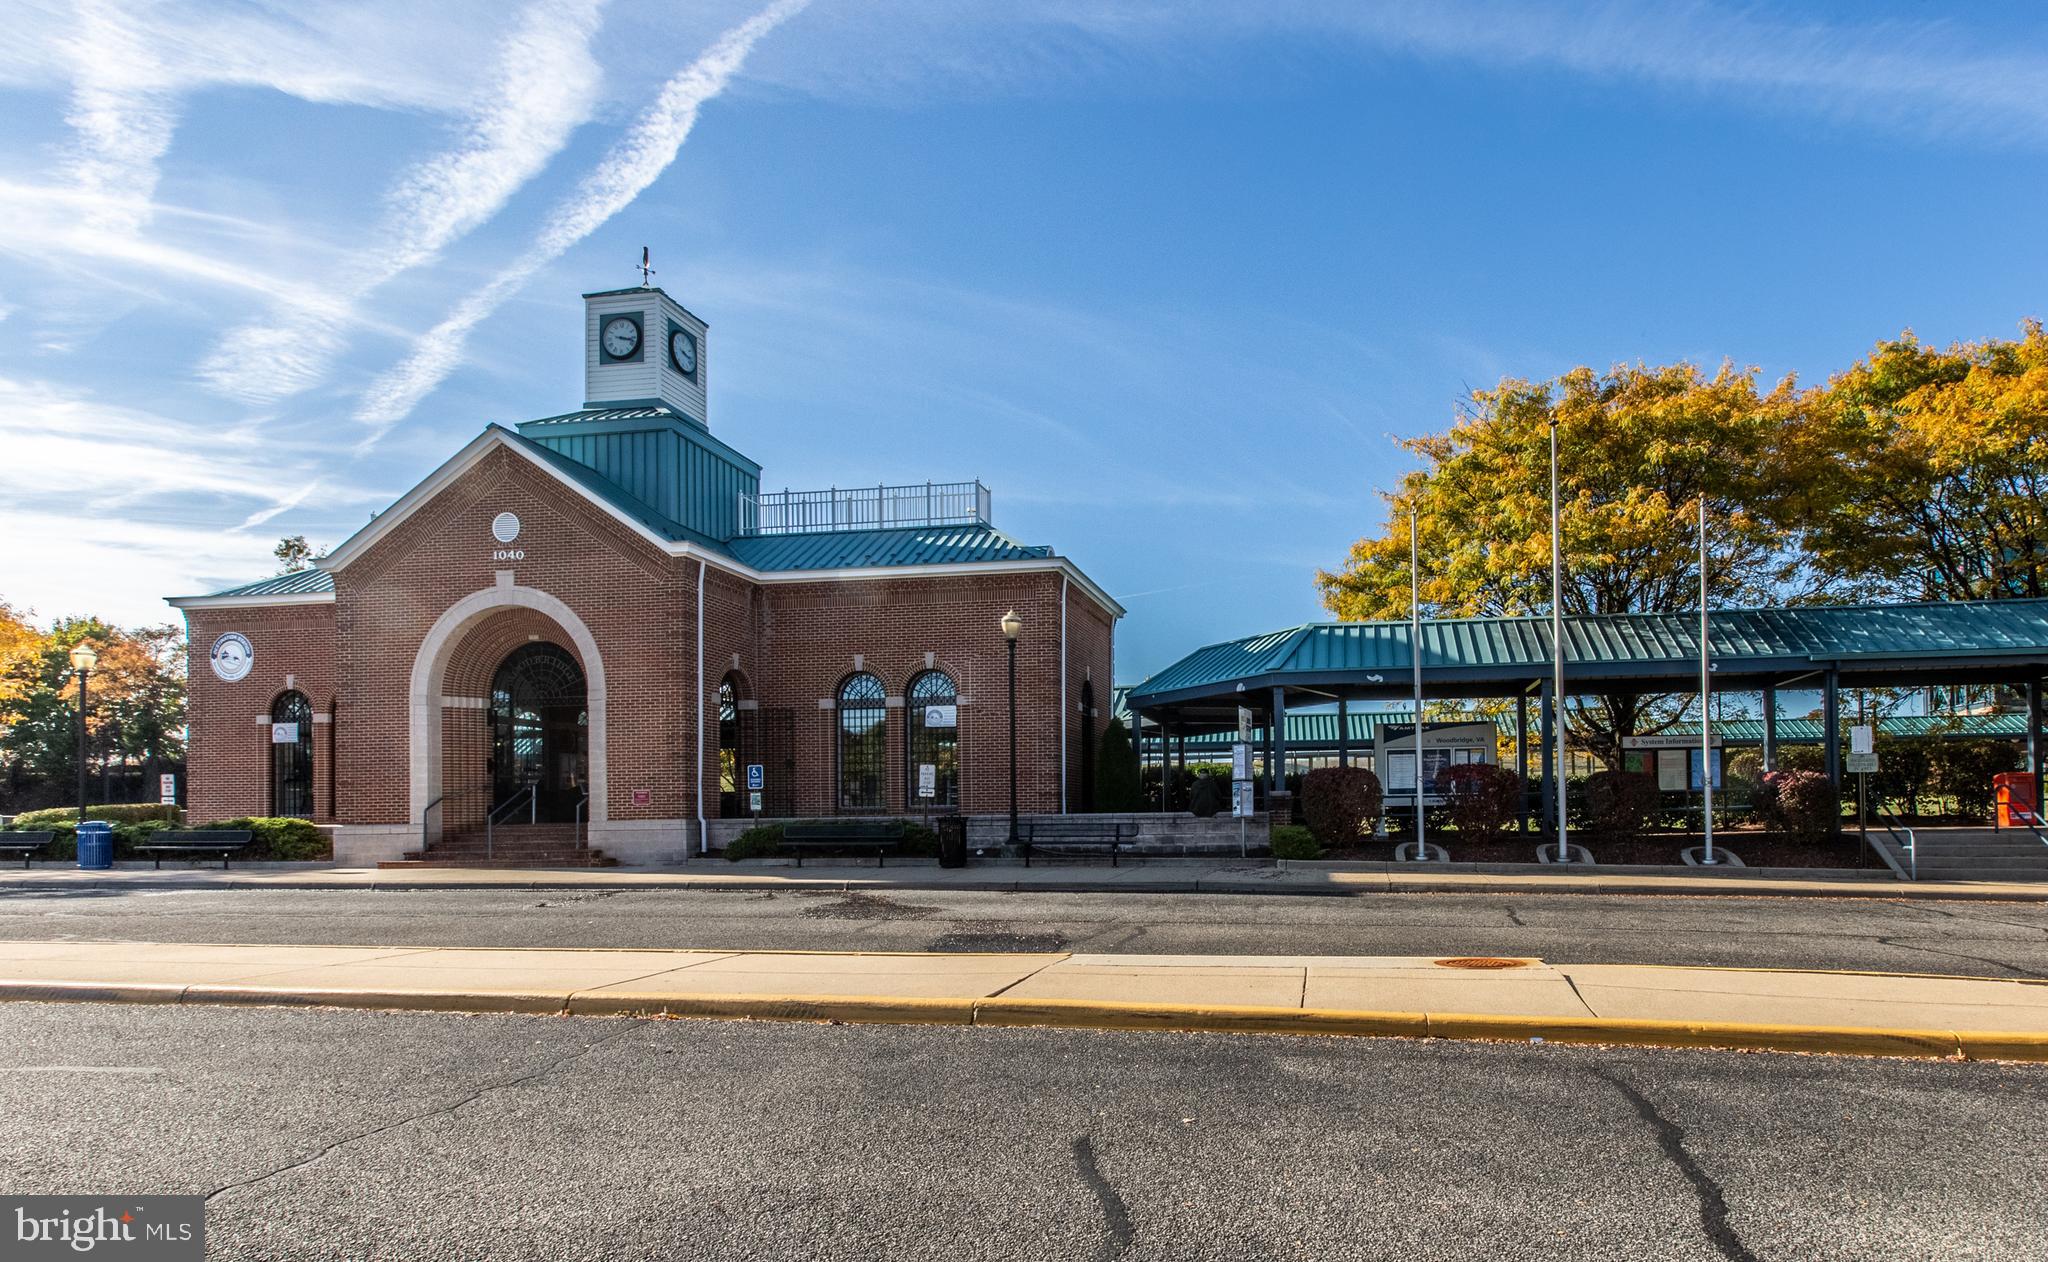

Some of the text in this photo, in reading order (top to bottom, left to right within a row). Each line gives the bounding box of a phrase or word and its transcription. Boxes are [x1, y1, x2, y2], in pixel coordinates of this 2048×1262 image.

[493, 550, 525, 560] 1040
[1435, 736, 1475, 744] Woodbridge,
[1640, 737, 1703, 747] System Informatio
